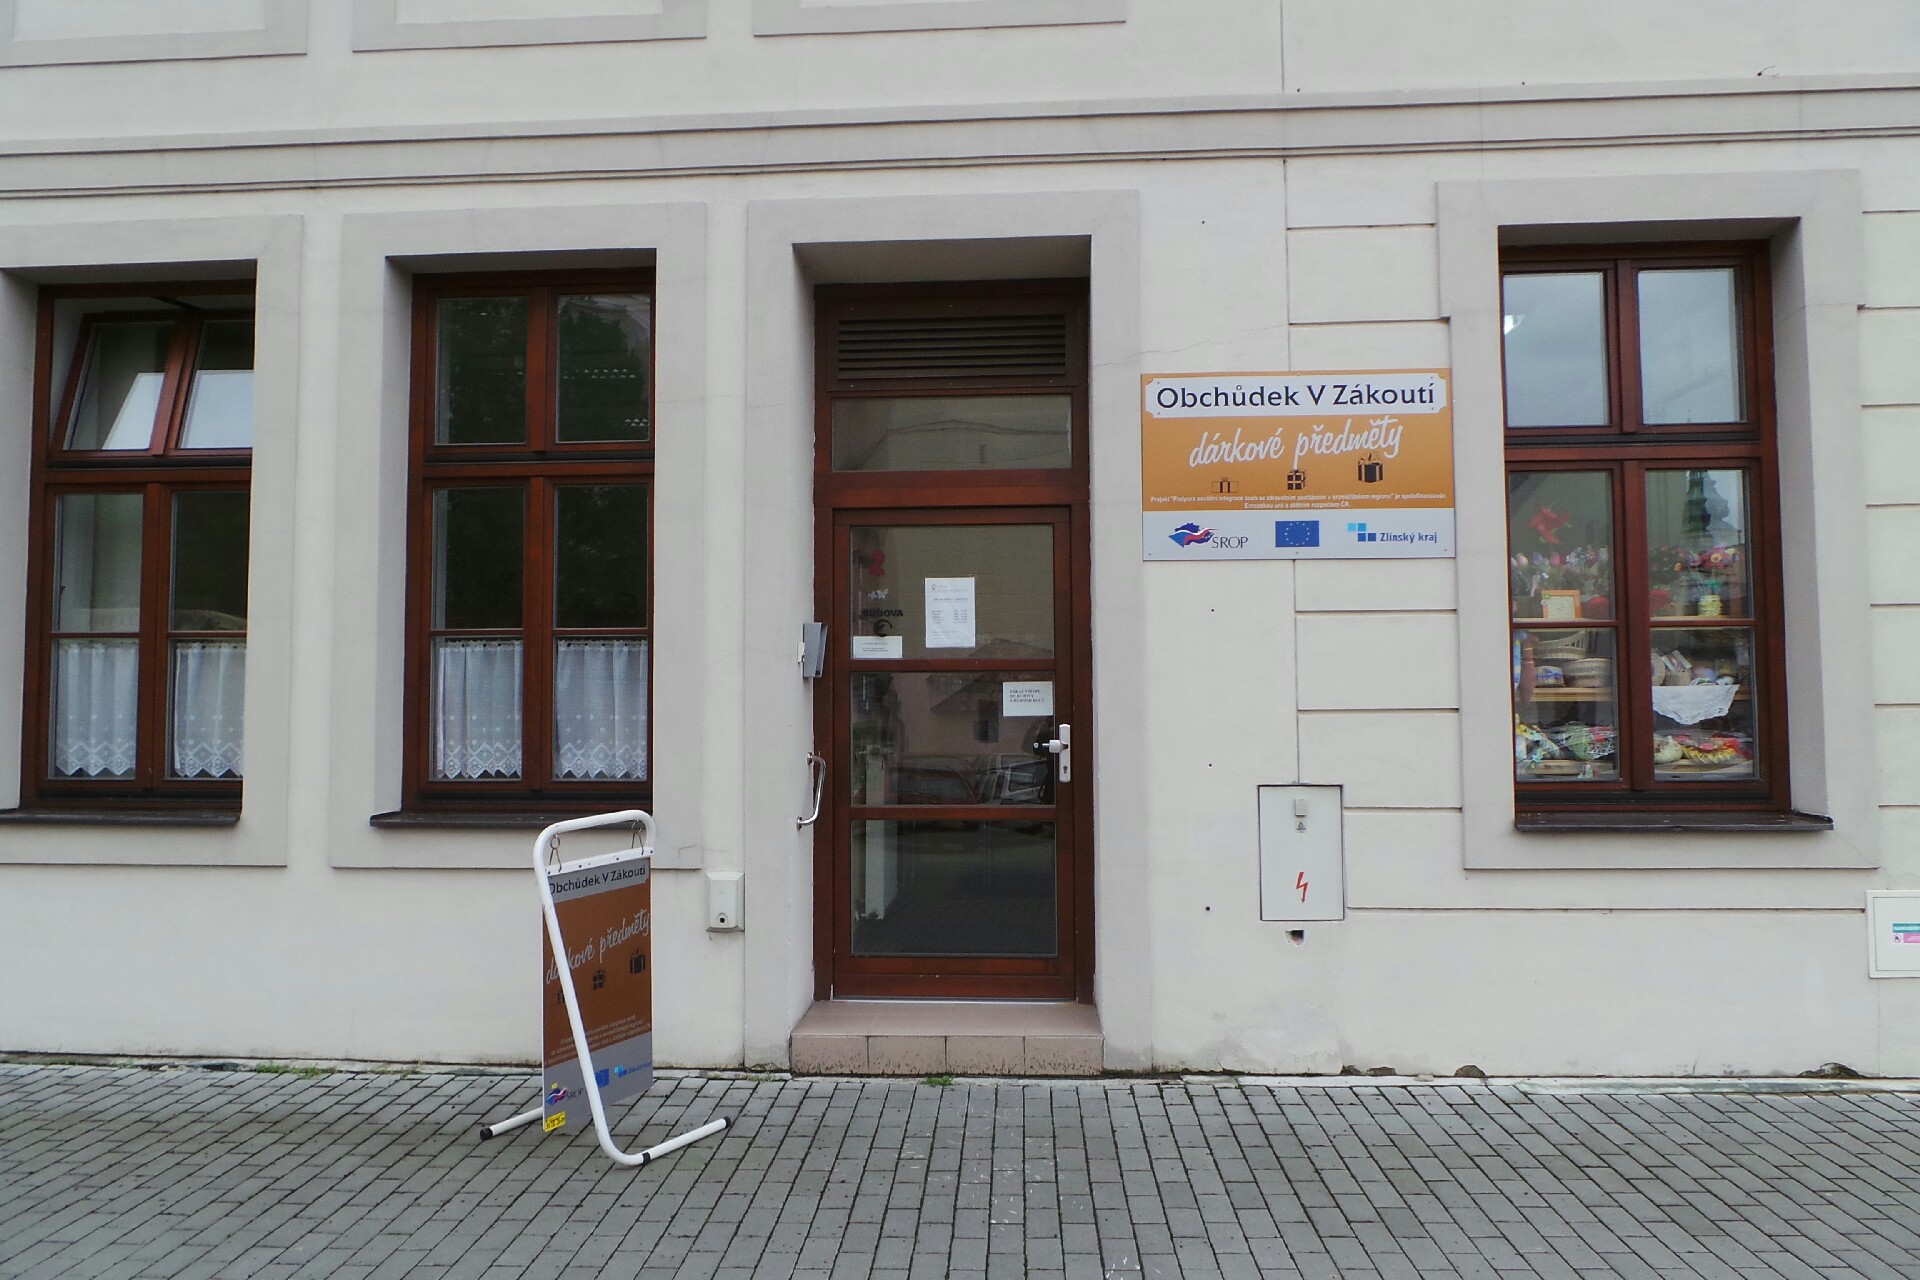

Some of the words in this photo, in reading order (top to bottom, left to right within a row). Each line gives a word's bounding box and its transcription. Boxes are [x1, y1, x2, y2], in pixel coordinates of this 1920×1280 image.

[1157, 385, 1300, 409] Obchůdek
[1306, 384, 1326, 406] V
[1332, 382, 1434, 405] Zákoutí
[1189, 427, 1285, 468] dárkové
[1293, 415, 1403, 470] předměty
[1211, 536, 1249, 549] SROP
[1418, 531, 1438, 543] kraj
[602, 872, 610, 884] V
[600, 908, 650, 964] předměty
